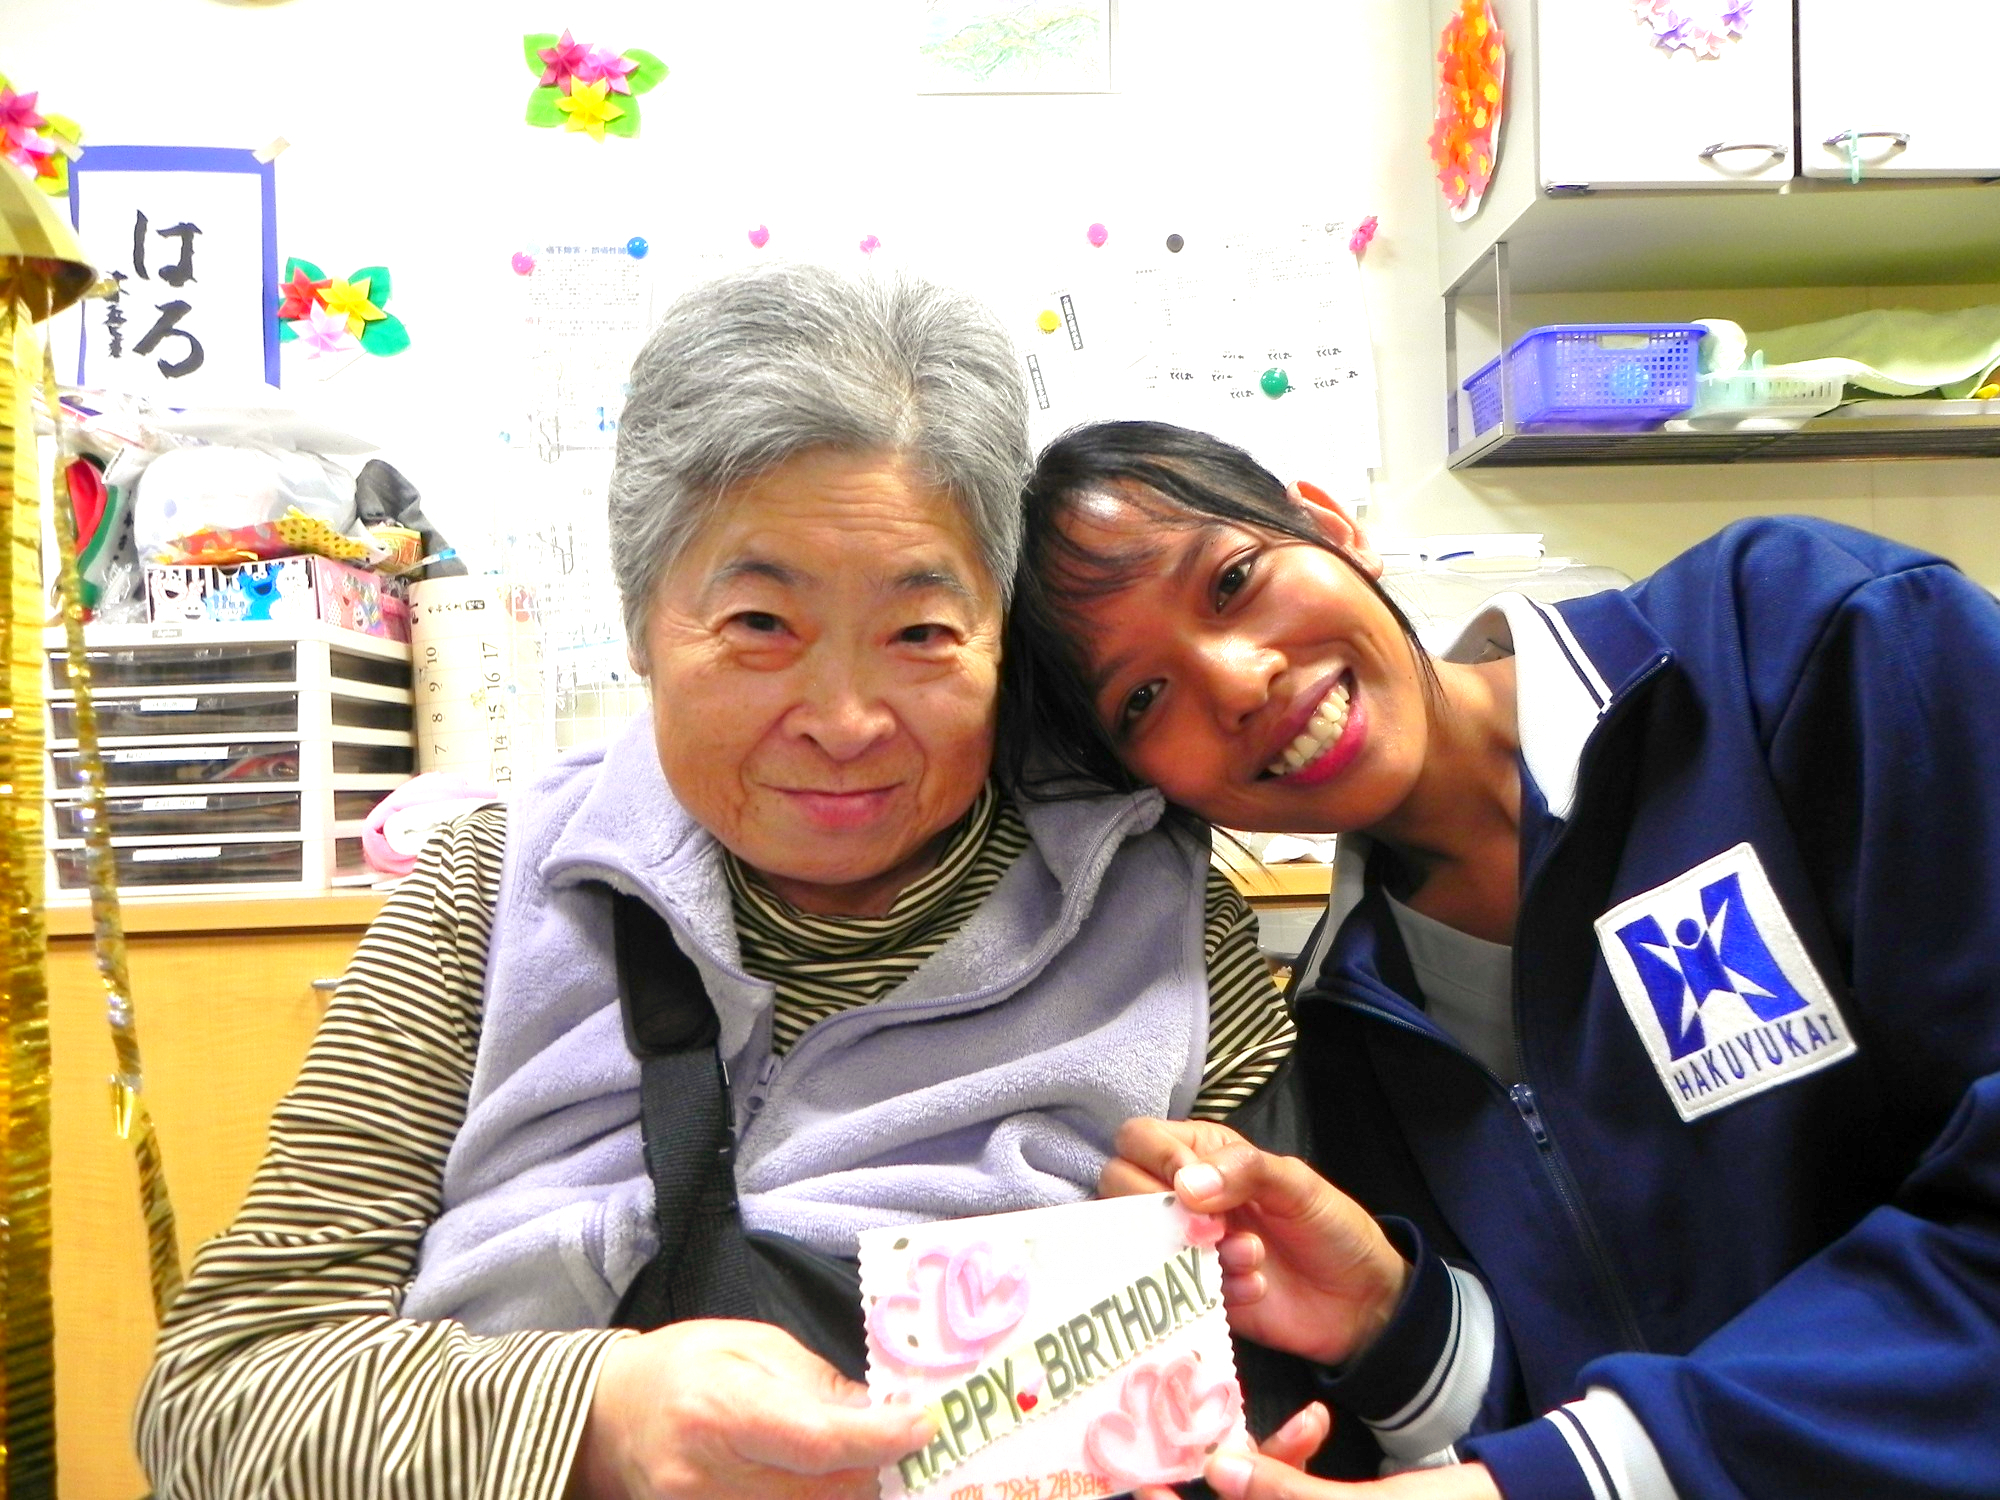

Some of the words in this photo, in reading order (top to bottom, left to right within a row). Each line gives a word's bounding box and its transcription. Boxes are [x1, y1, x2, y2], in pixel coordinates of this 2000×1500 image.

[427, 647, 438, 664] 10
[483, 642, 499, 658] 17
[430, 682, 441, 692] 9
[485, 673, 500, 690] 16
[433, 713, 442, 723] 8
[435, 745, 447, 755] 7
[494, 735, 508, 753] 14
[496, 766, 512, 783] 13
[1673, 1014, 1837, 1101] HAKUYUKAI
[898, 1358, 1020, 1489] HAPPY
[1036, 1246, 1213, 1400] BIRTHDAY
